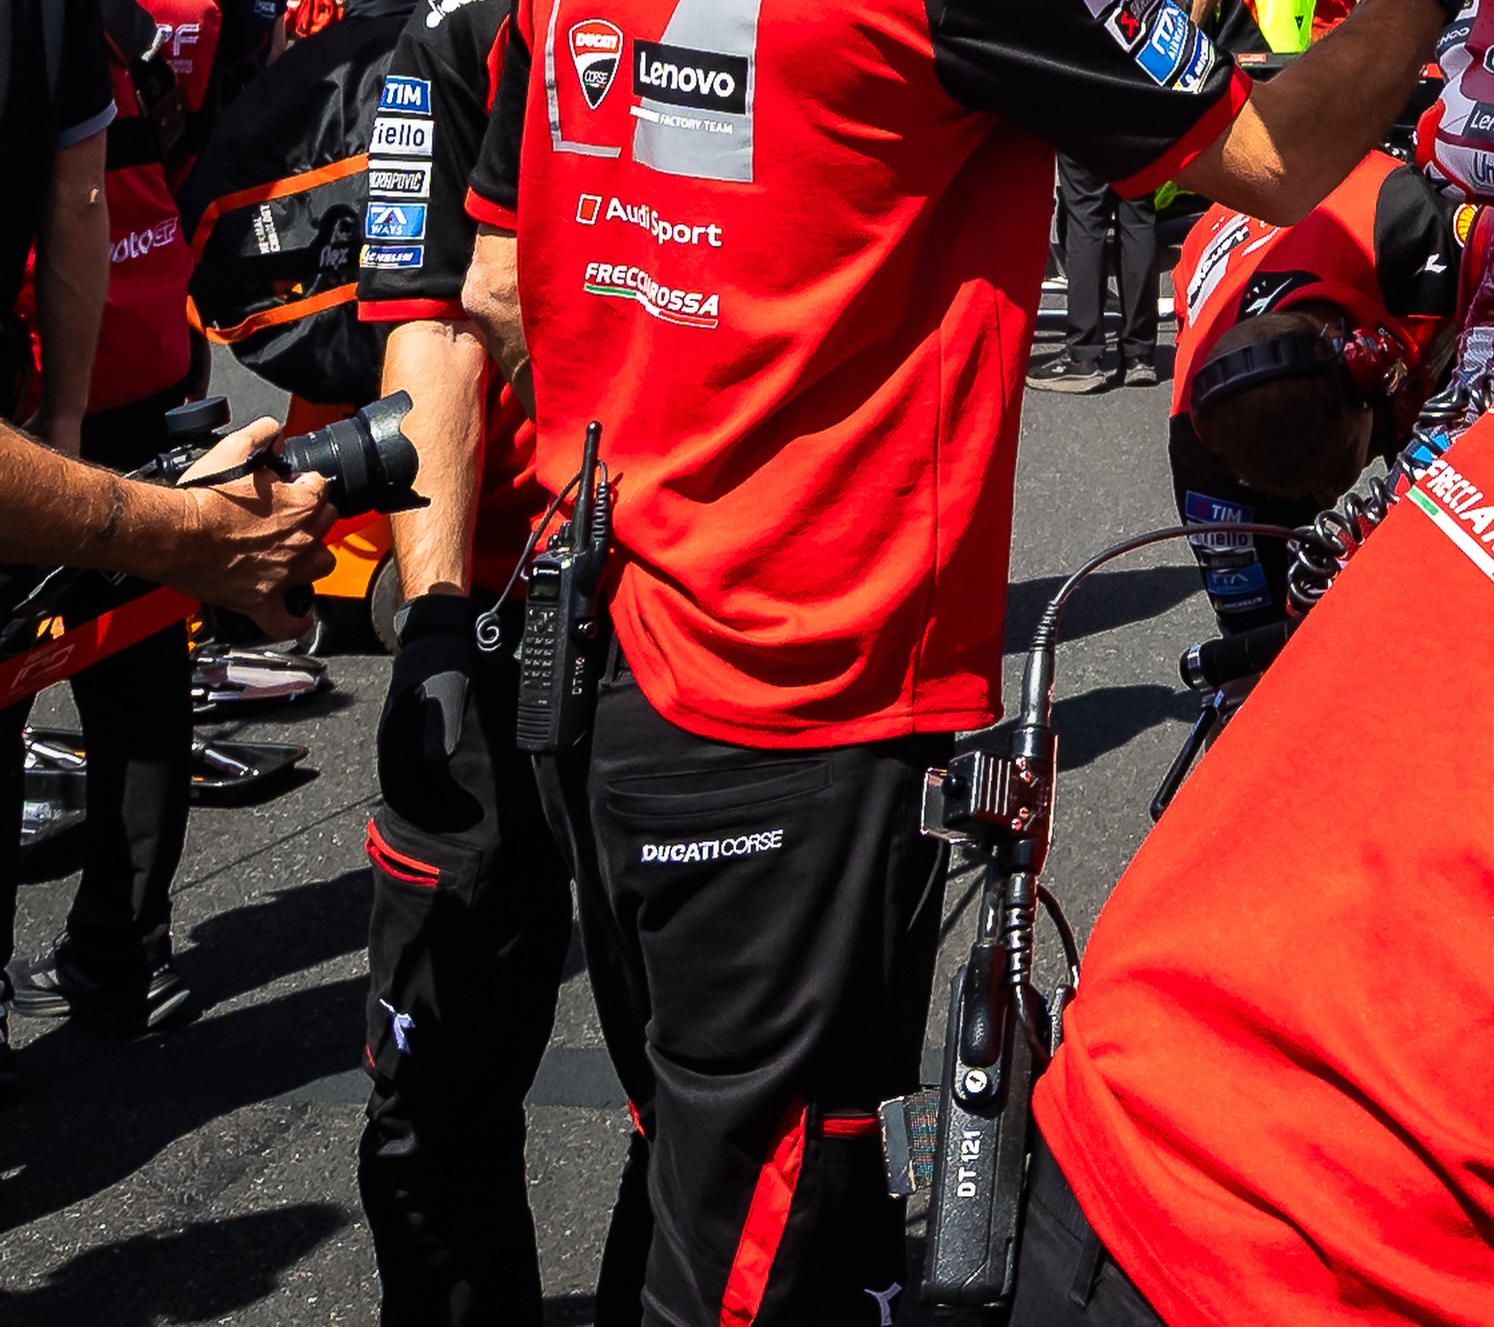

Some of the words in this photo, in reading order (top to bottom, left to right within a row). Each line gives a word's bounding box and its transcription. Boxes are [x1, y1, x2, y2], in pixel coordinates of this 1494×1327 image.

[575, 32, 618, 50] DUCATI
[585, 69, 608, 84] CORSE
[640, 51, 736, 98] Lenovo
[387, 83, 422, 106] TIM
[660, 115, 703, 132] FACTORY
[704, 120, 734, 135] TEAM
[604, 197, 651, 231] Audi
[650, 208, 723, 247] Sport
[1212, 504, 1242, 524] TIM
[641, 840, 719, 863] DUCATI
[721, 829, 784, 856] CORSE
[960, 1129, 983, 1163] 121
[957, 1166, 977, 1197] DT
